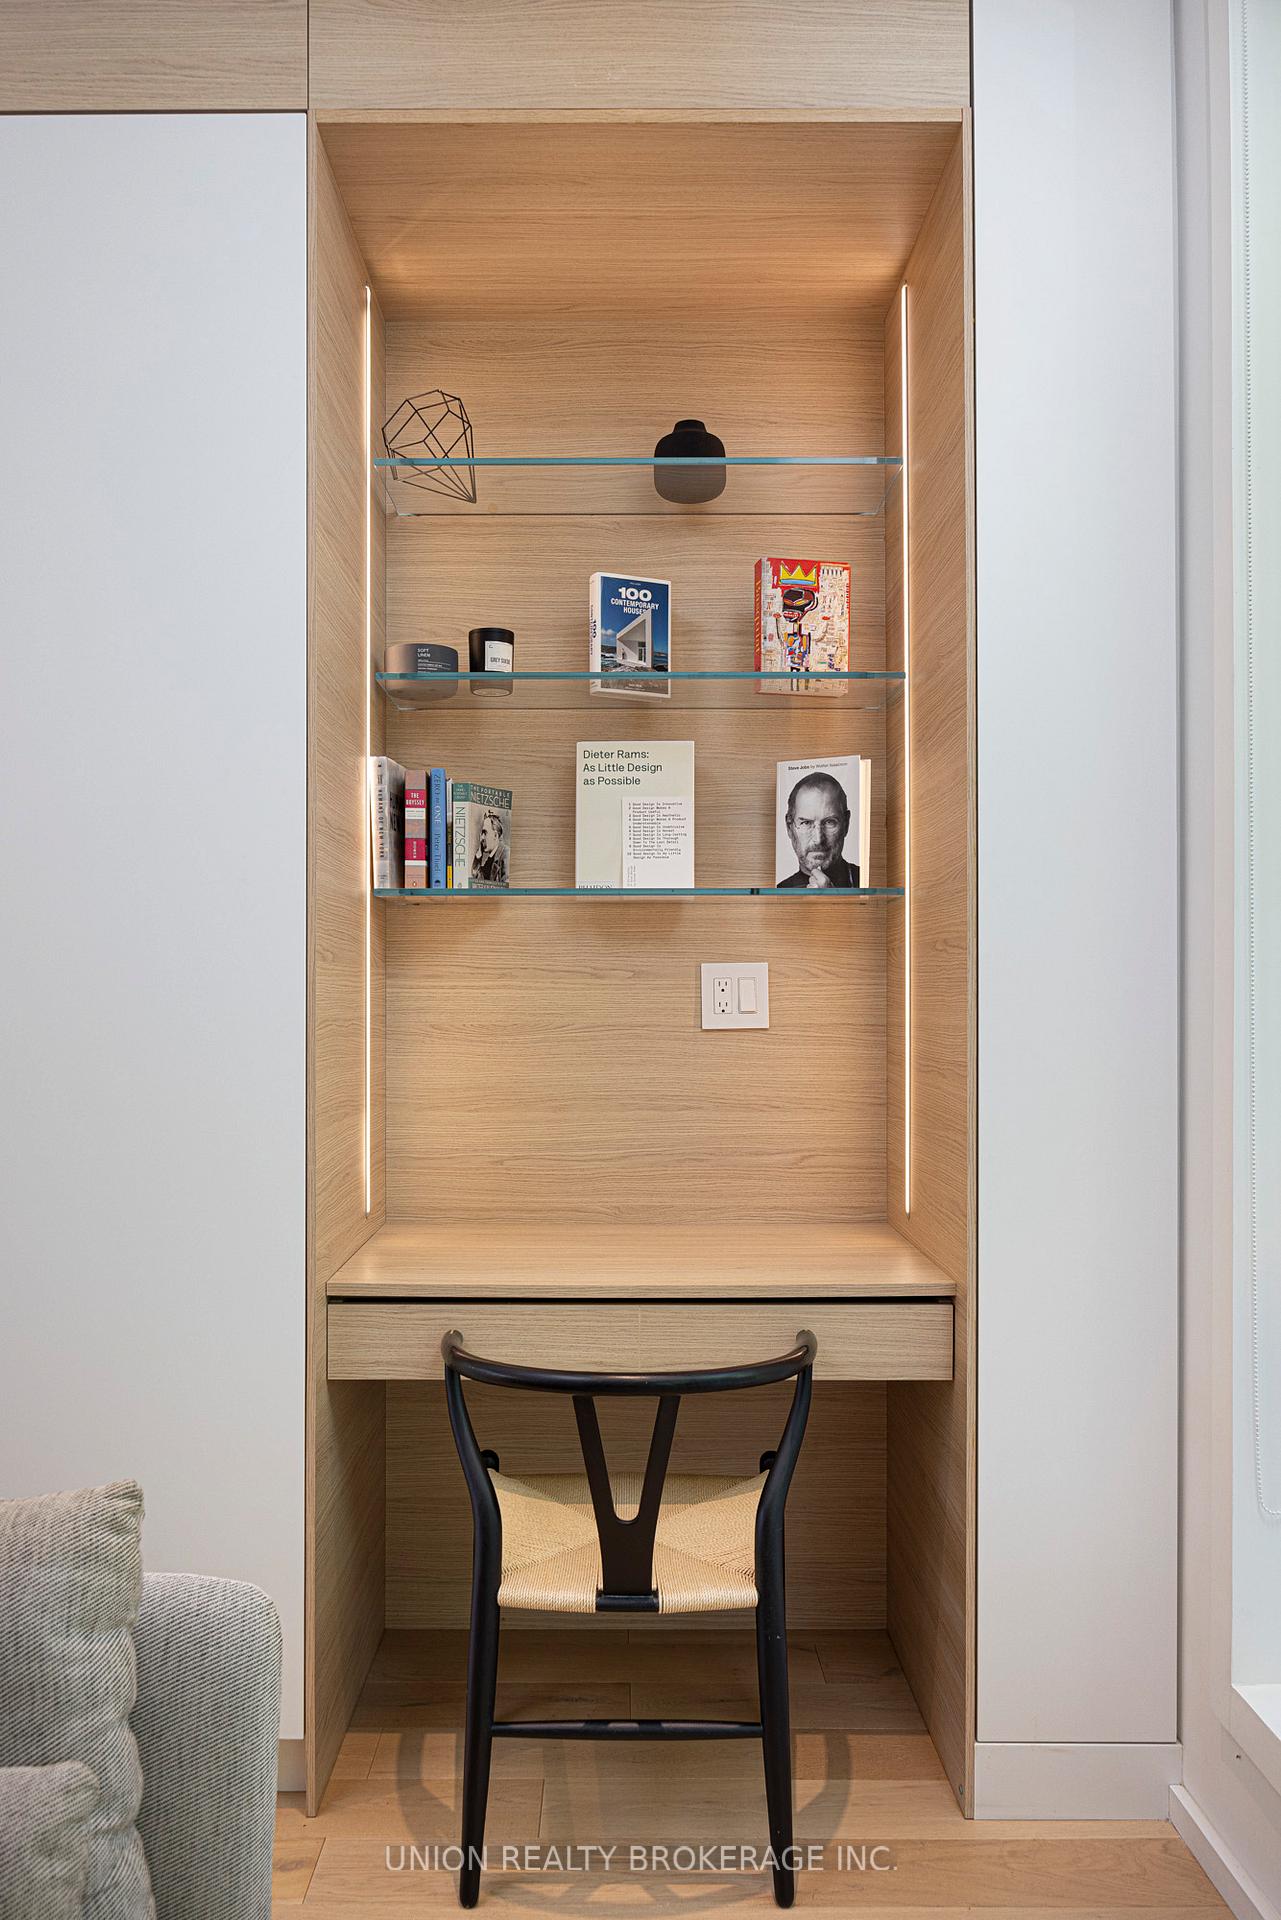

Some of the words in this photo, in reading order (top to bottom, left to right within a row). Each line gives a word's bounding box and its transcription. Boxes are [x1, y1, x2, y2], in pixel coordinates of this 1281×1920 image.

[618, 587, 652, 601] 100
[610, 598, 659, 610] CONTEMPORARY
[583, 750, 614, 759] Dieter
[617, 750, 649, 759] Rams:
[583, 764, 595, 772] As
[598, 764, 624, 772] Little
[627, 763, 662, 774] Design
[598, 776, 640, 785] Possible
[470, 791, 510, 809] NIETZSCHE
[455, 806, 466, 867] NIETZSCHE
